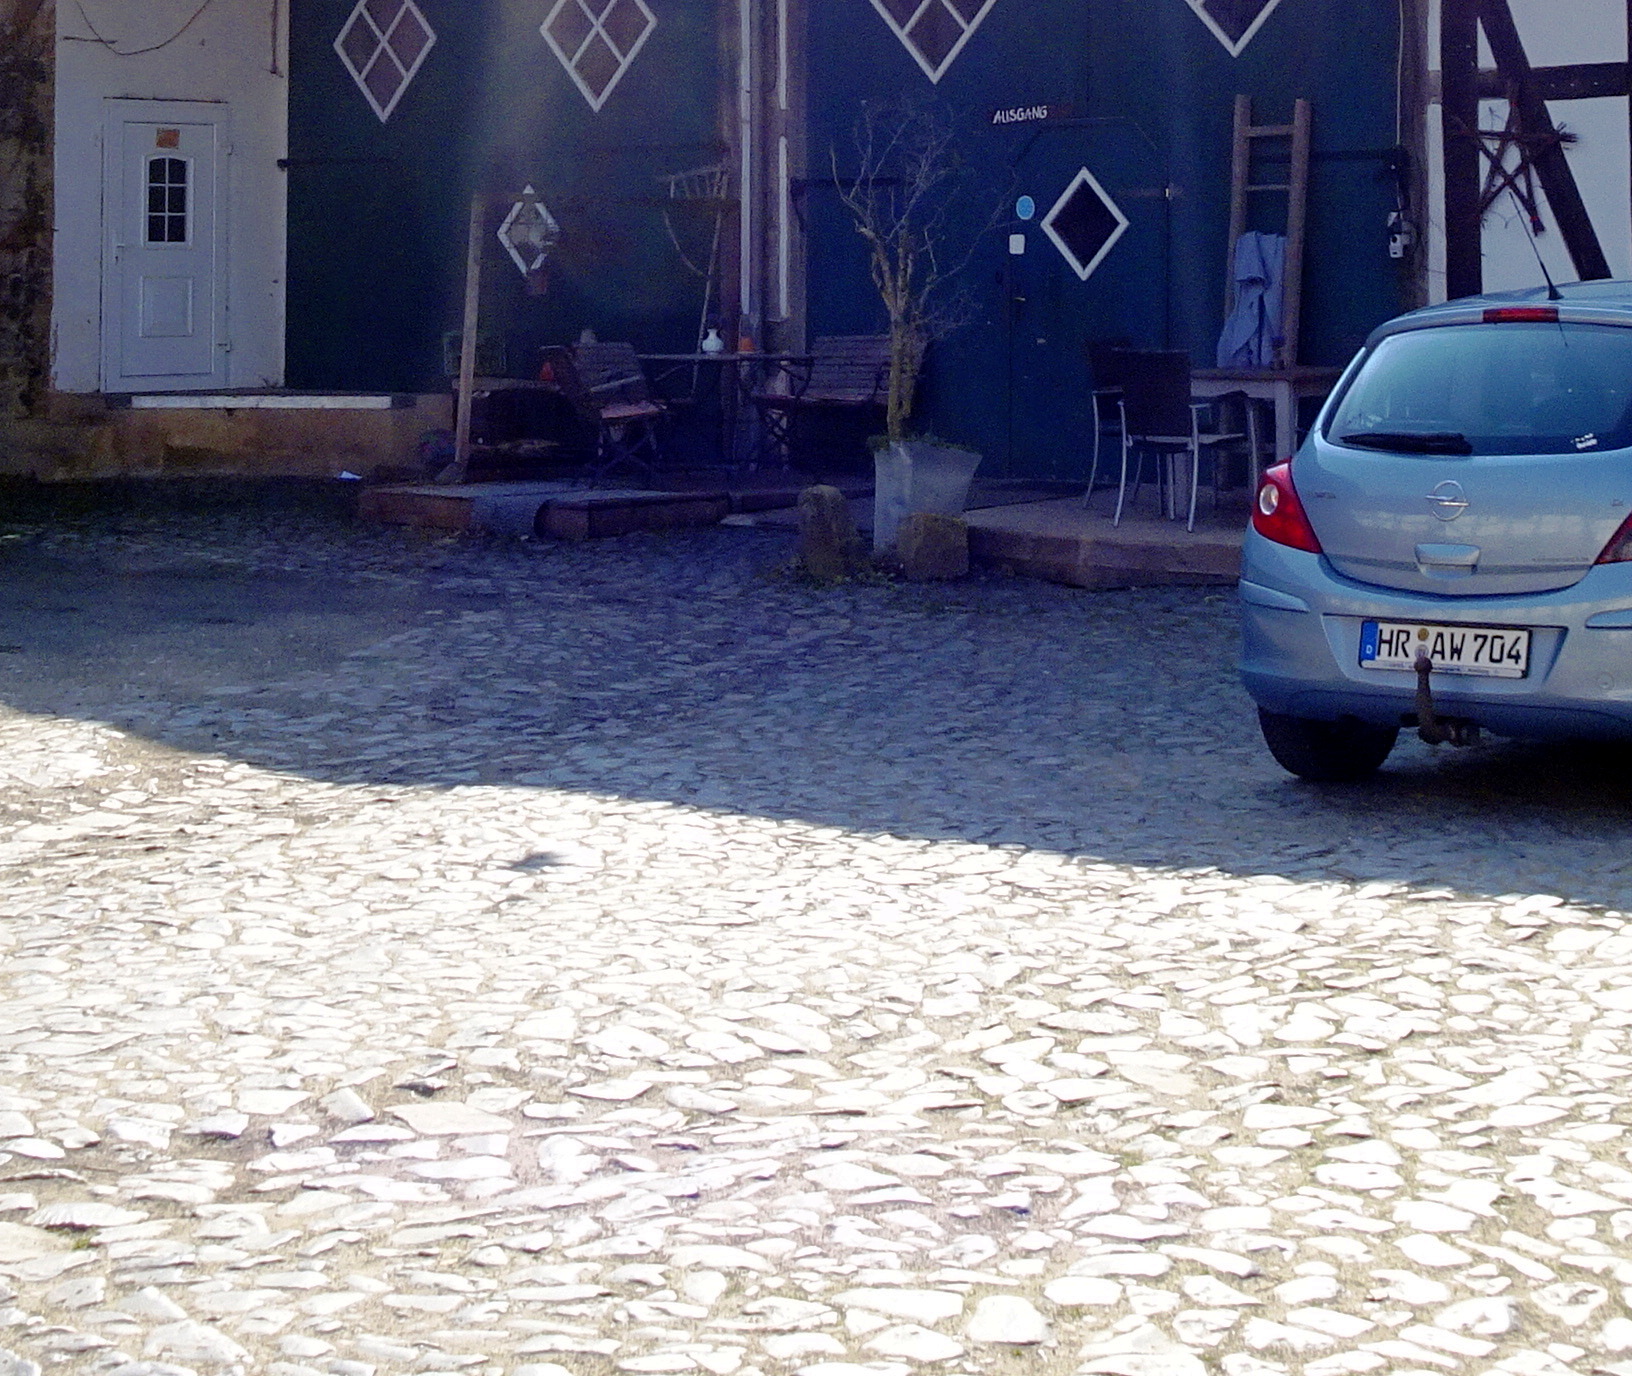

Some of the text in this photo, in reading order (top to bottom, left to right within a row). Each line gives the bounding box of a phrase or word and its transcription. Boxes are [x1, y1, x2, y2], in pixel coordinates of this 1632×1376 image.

[992, 105, 1048, 124] AUSGANG
[1377, 629, 1522, 665] HR AW 704
